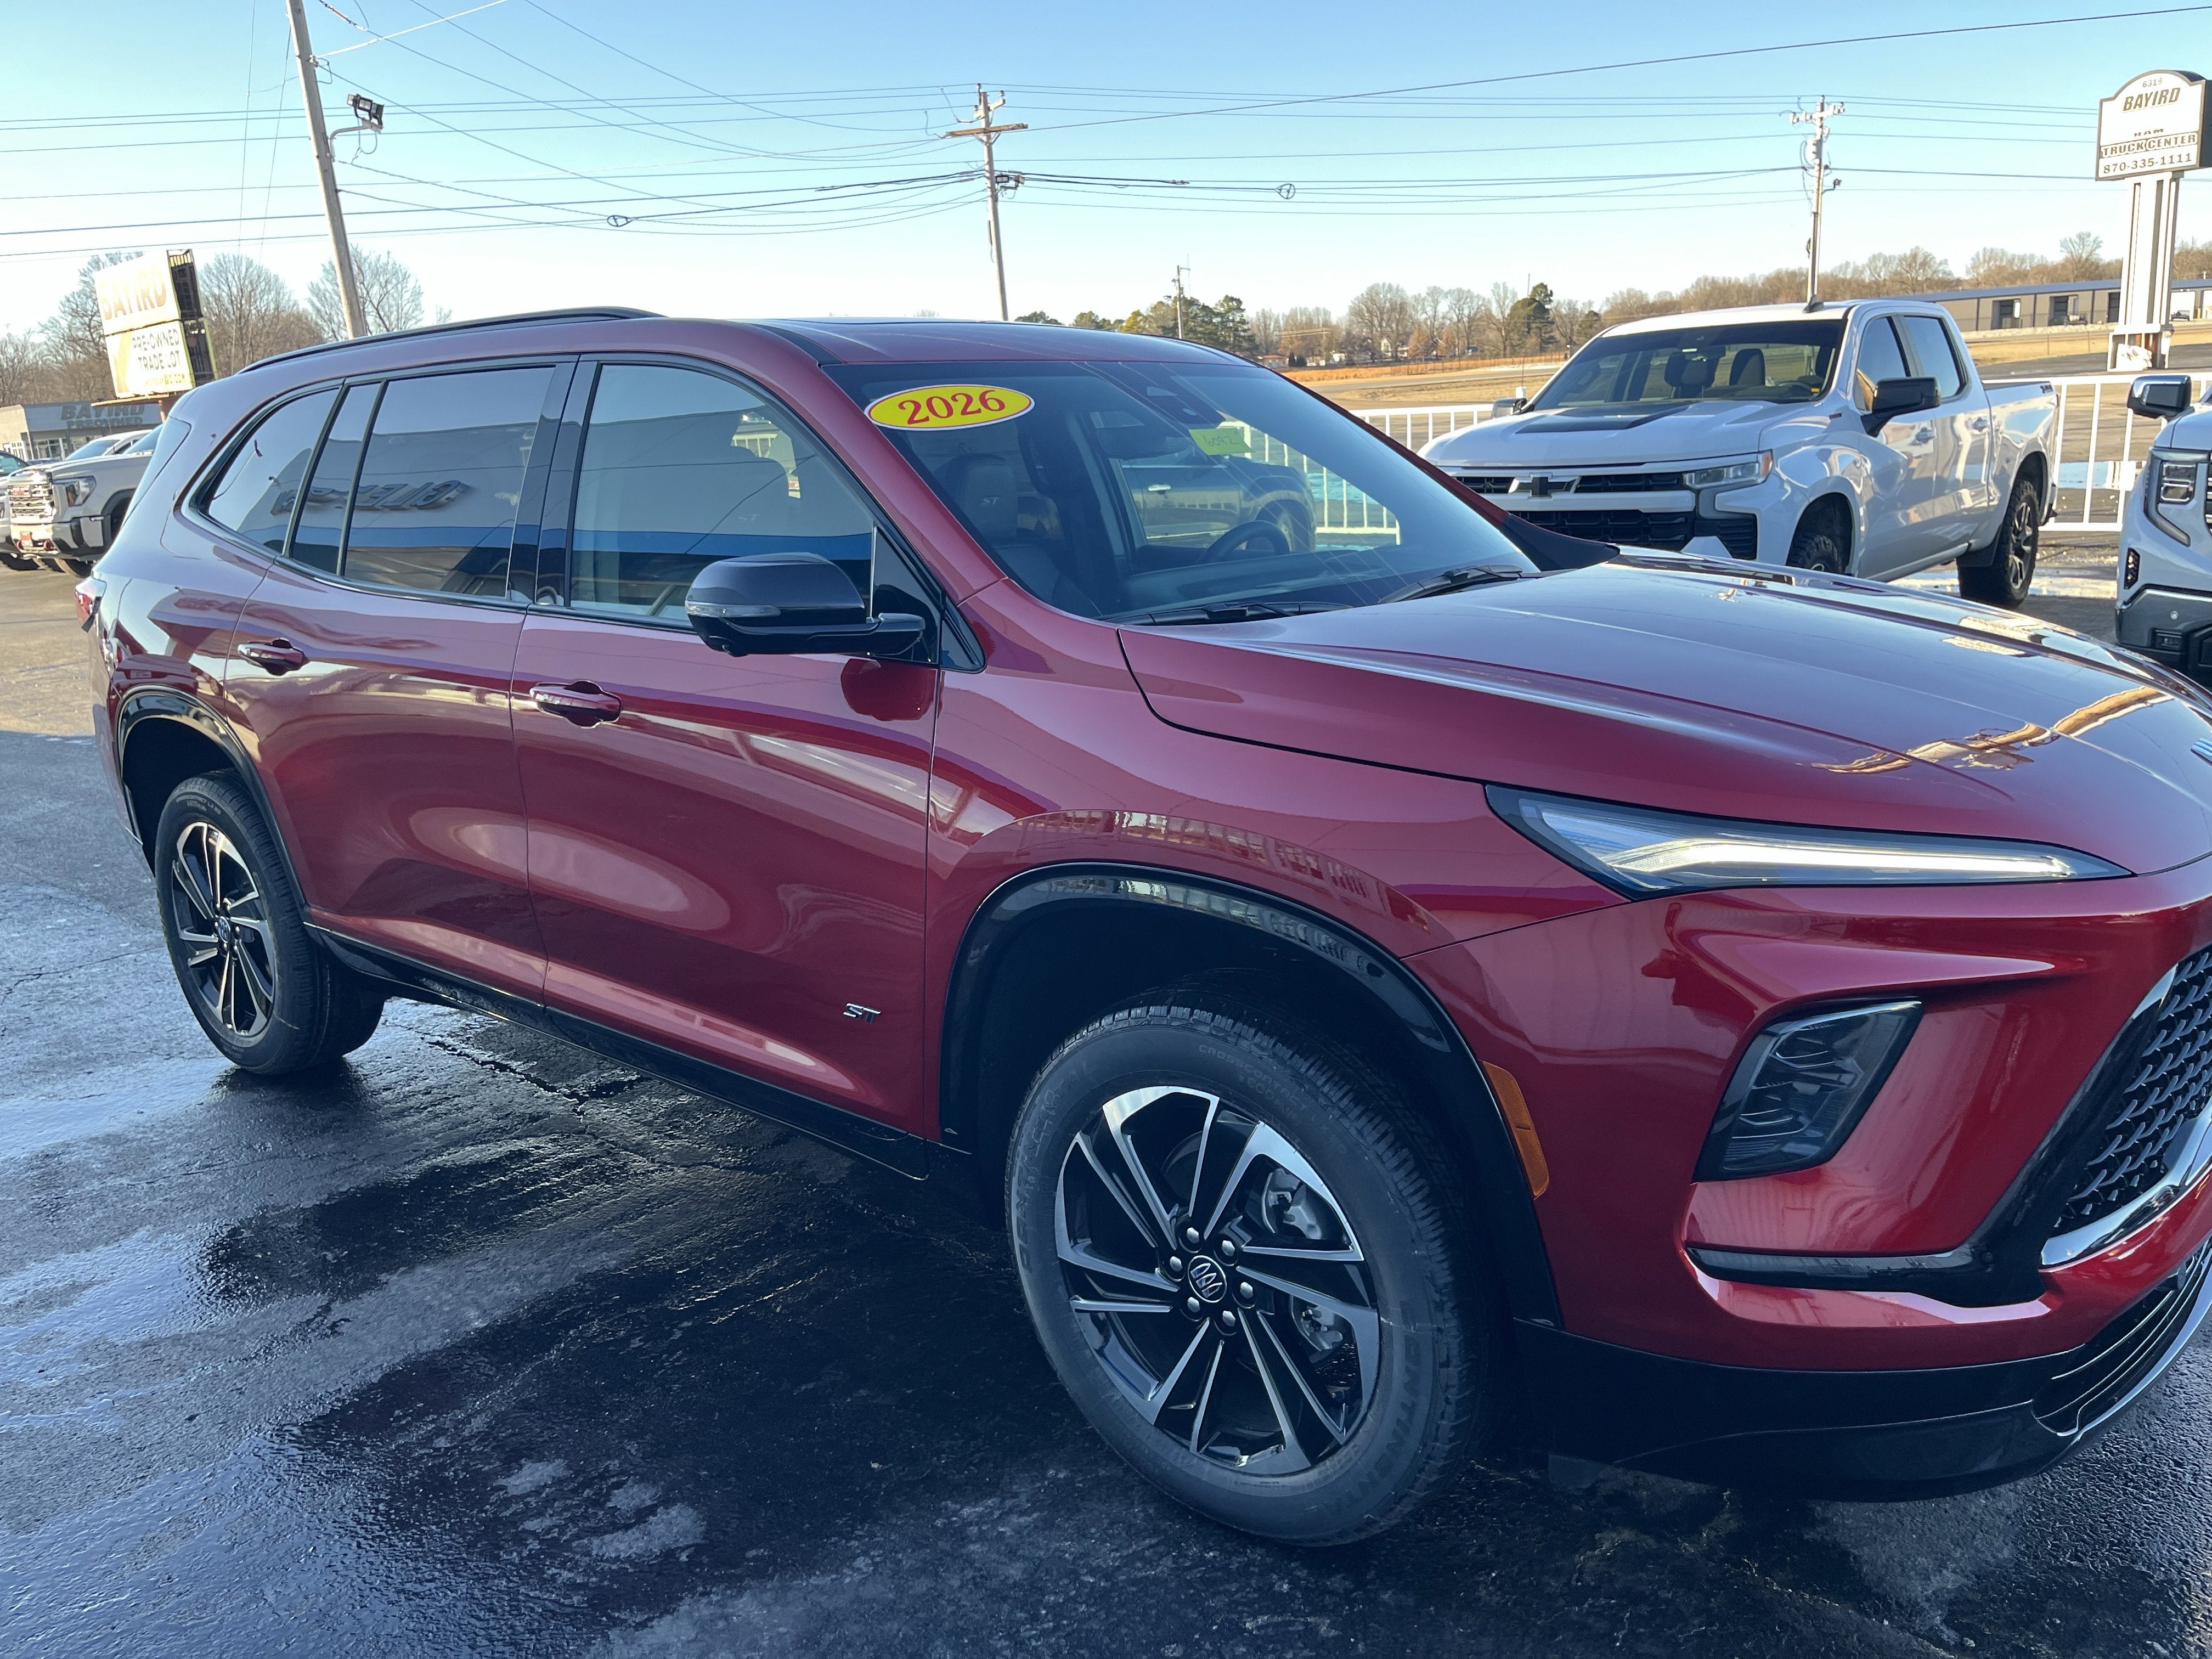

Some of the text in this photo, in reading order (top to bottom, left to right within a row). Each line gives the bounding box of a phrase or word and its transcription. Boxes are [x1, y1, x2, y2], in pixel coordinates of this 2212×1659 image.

[2123, 87, 2181, 111] BAYIRD
[2103, 135, 2196, 156] TRUCK CENTER
[2103, 153, 2192, 174] 870-335-1111
[138, 351, 182, 371] TRADE LOT
[898, 390, 1006, 425] 2026
[1203, 435, 1241, 447] 6092
[981, 496, 1001, 505] ST
[843, 1003, 881, 1023] ST
